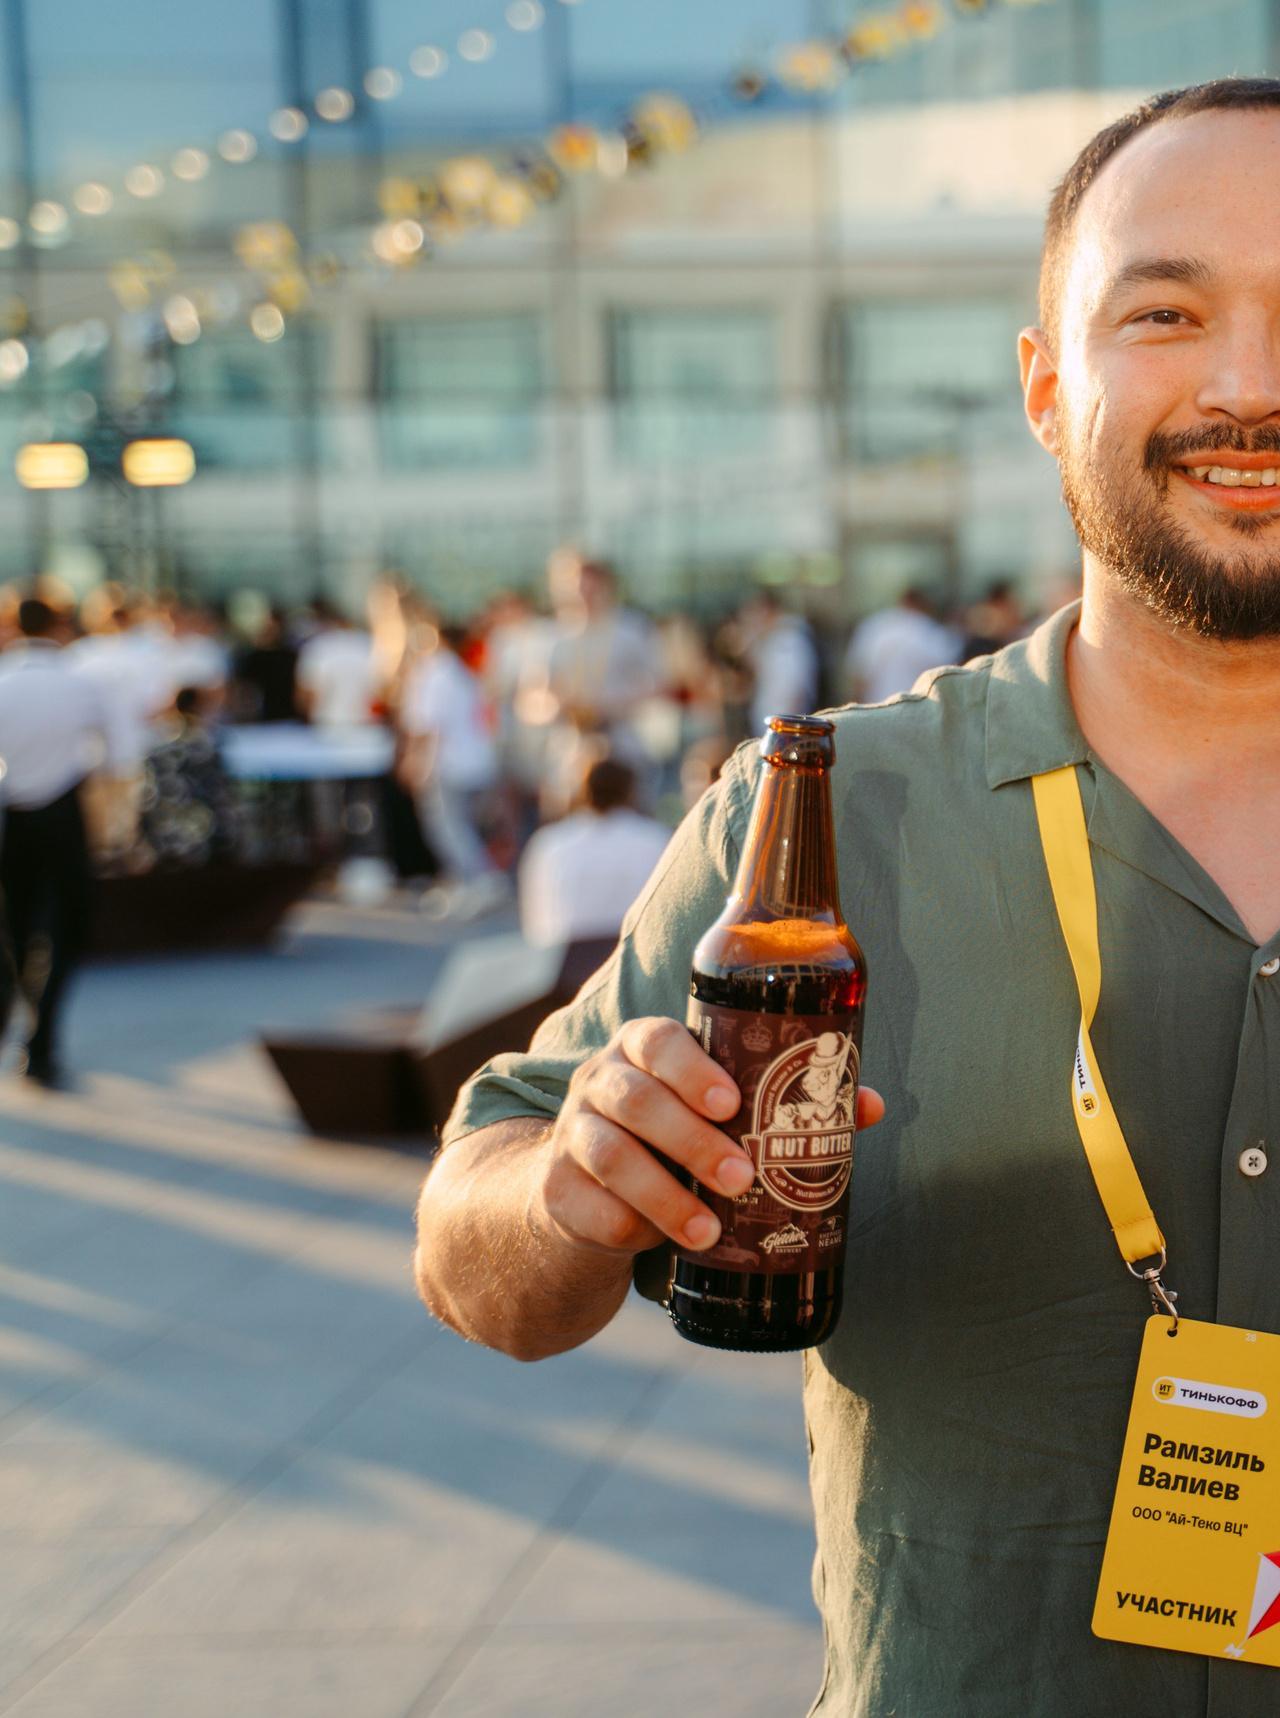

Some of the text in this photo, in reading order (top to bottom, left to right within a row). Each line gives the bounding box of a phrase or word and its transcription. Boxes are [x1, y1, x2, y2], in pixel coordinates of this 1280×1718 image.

[703, 1016, 712, 1055] ДОРОВЬЮ
[764, 1092, 775, 1123] Shepherd
[771, 1070, 788, 1091] Neame
[770, 1132, 852, 1158] NUT BUTTER
[818, 1234, 842, 1248] NEAME
[1245, 1332, 1257, 1343] 28
[1159, 1384, 1259, 1409] ИТ ТИНЬКОФФ
[1143, 1433, 1265, 1473] Рамзиль
[1138, 1464, 1240, 1501] Валиев
[1132, 1506, 1248, 1537] ООО "Ай-Теко ВЦ"
[1116, 1591, 1238, 1627] УЧАСТНИК
